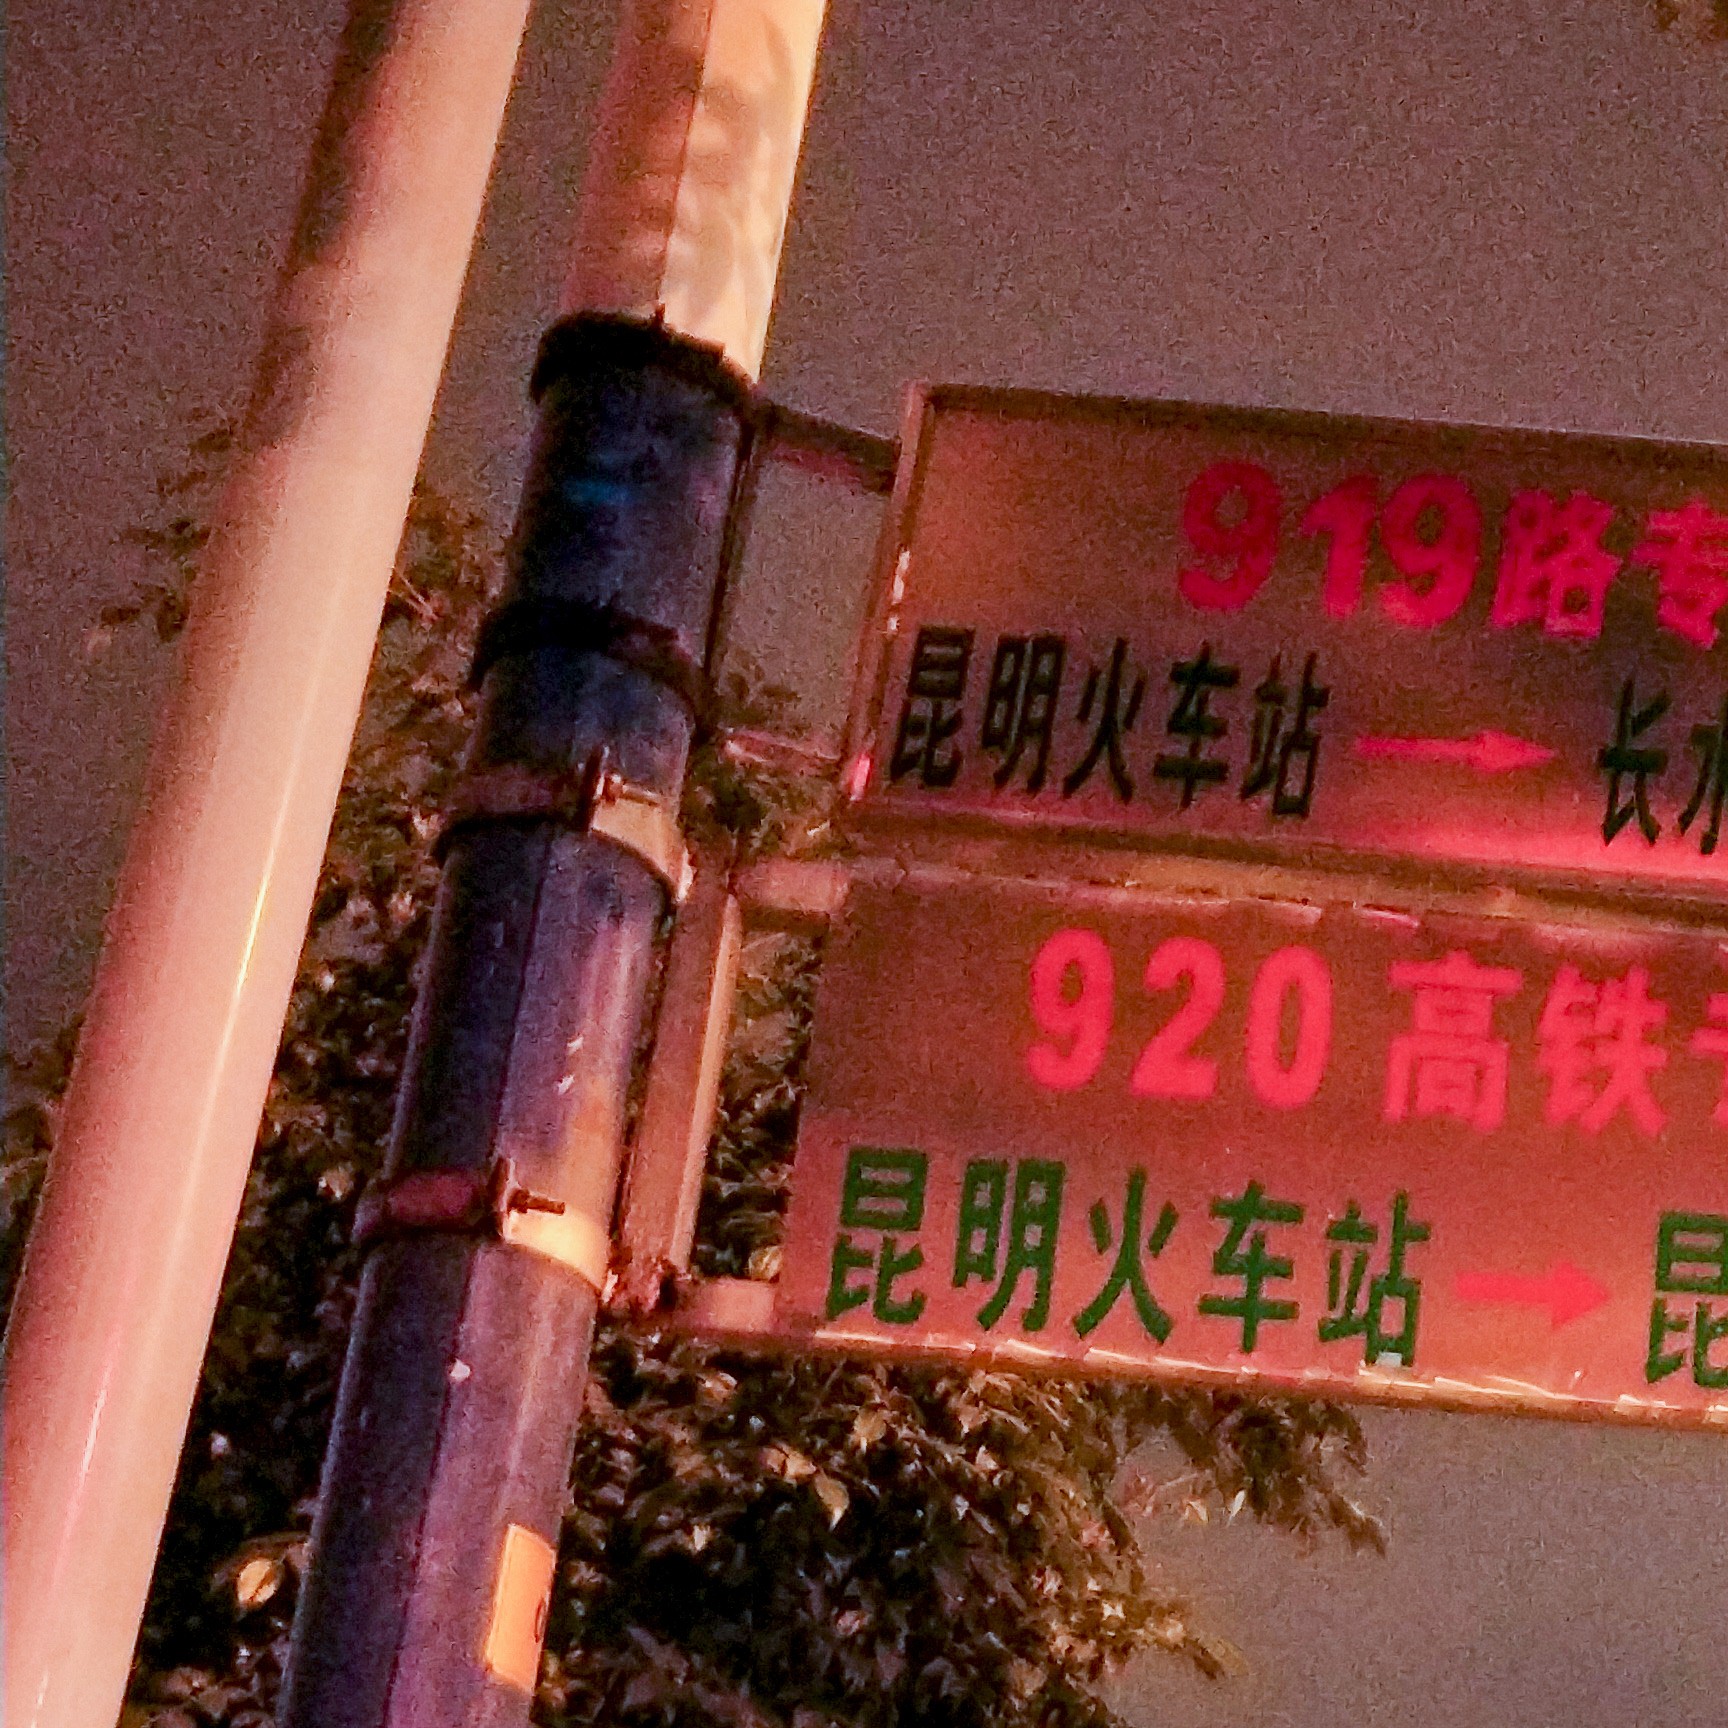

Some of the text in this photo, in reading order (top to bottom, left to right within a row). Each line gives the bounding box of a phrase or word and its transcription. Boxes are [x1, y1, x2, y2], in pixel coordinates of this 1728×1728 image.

[890, 625, 1332, 819] 昆明火车站
[826, 1146, 1432, 1368] 昆明火车站
